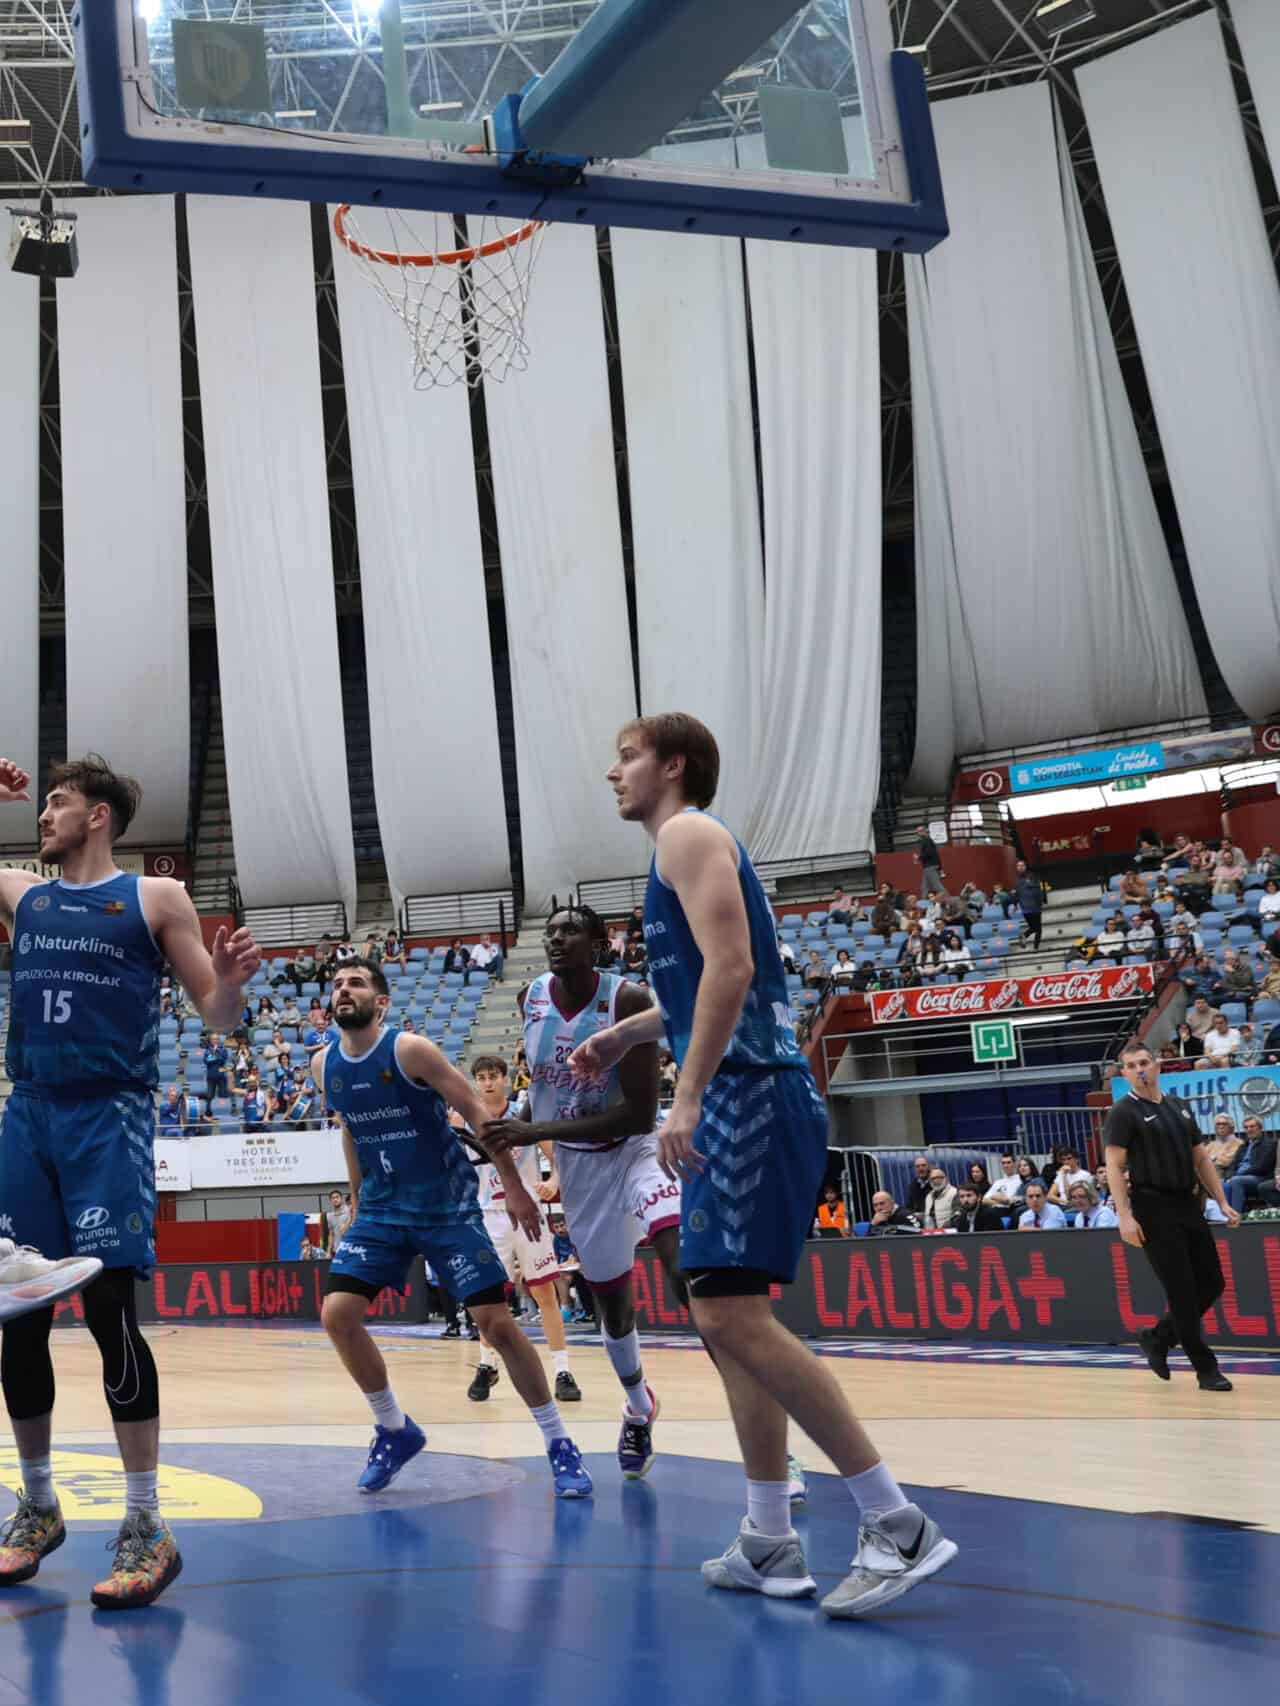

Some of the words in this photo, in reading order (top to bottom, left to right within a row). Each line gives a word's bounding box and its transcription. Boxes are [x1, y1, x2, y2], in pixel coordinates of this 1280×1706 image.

[1032, 762, 1082, 776] DONOSTIA
[1040, 839, 1071, 851] BAR
[34, 934, 125, 960] Naturklima
[43, 990, 73, 1023] 15
[226, 1158, 256, 1167] TRES
[260, 1156, 300, 1166] REYES
[241, 1147, 281, 1156] HOTEL
[154, 1268, 303, 1317] LALIGA+
[811, 1245, 1066, 1331] LALIGA+
